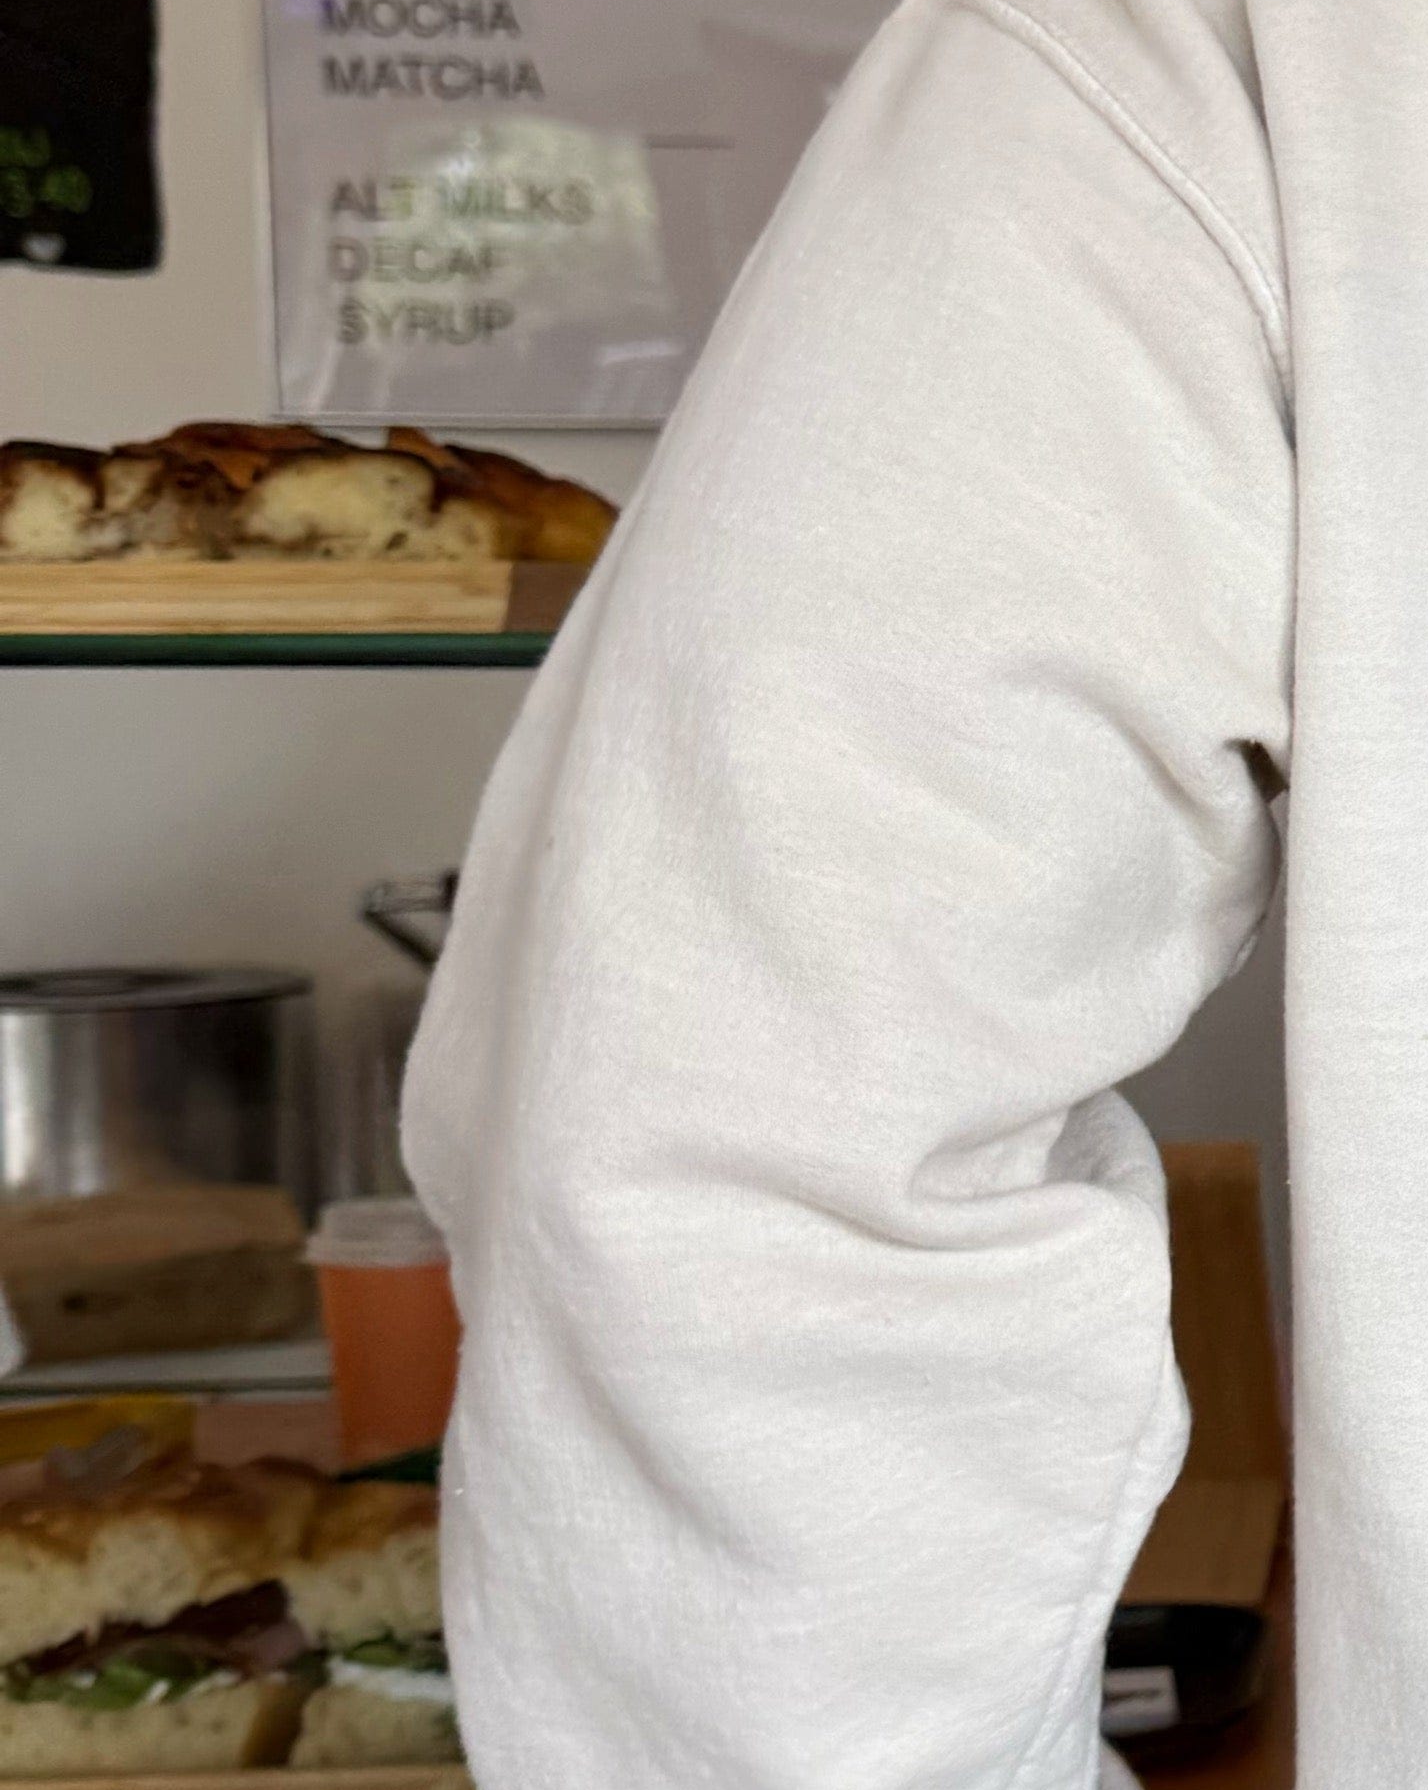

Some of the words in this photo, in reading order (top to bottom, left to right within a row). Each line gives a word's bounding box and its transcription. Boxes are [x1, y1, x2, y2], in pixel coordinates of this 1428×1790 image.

[321, 55, 546, 101] MATCHA
[331, 176, 414, 222] ALT
[436, 174, 594, 226] MILKS
[338, 298, 518, 345] SYRUP
